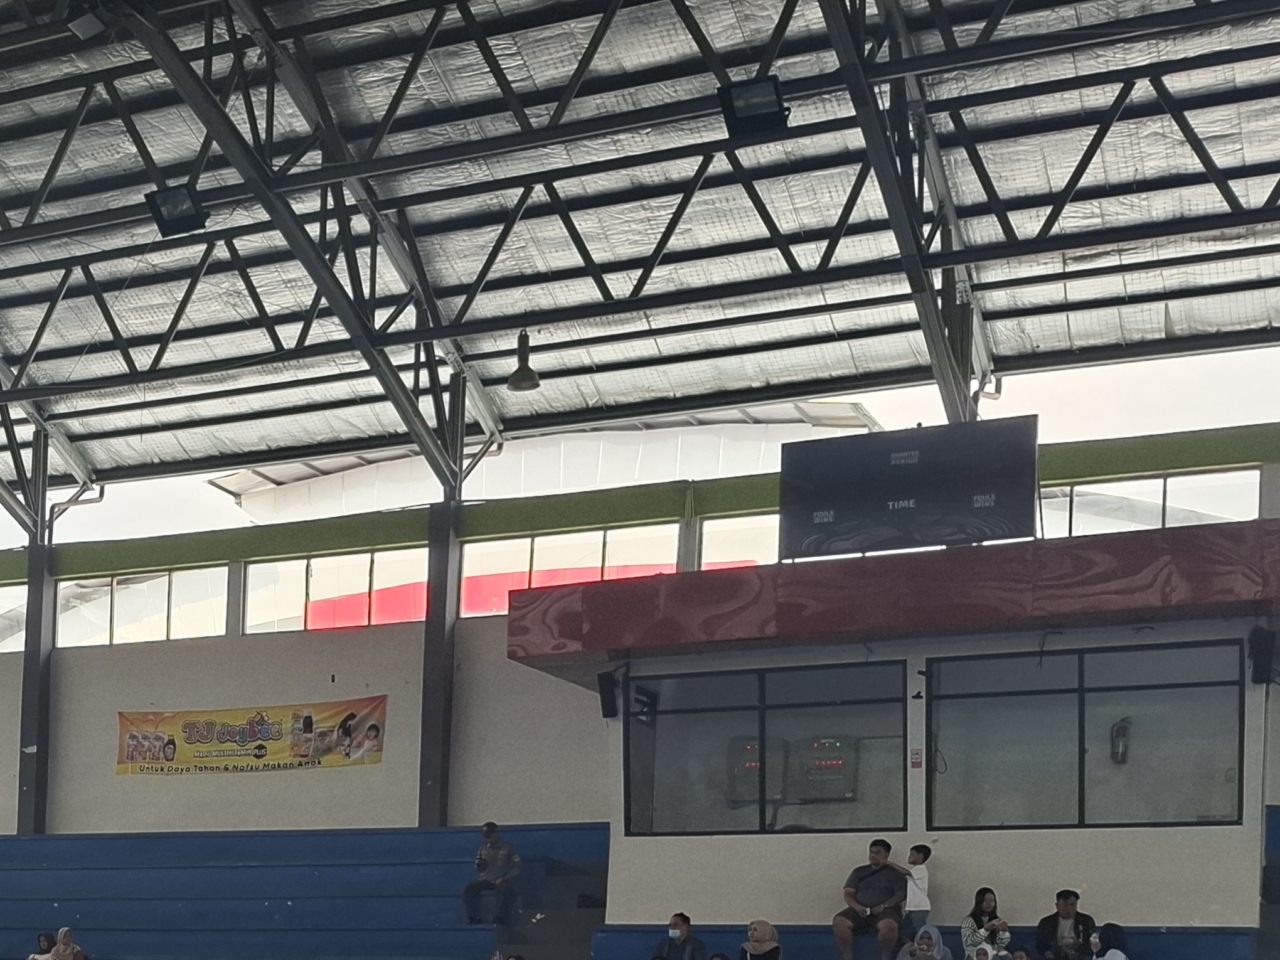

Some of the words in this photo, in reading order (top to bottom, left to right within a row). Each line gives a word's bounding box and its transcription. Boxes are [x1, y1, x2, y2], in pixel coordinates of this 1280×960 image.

[887, 499, 916, 510] TIME
[182, 720, 216, 743] TJ
[217, 717, 284, 746] Joybee
[139, 764, 165, 773] Untuk
[167, 764, 191, 774] Daya
[193, 764, 221, 772] Tahan
[223, 764, 230, 772] &
[232, 762, 260, 772] Nafsu
[262, 761, 296, 770] Makan
[297, 758, 323, 768] Anak
